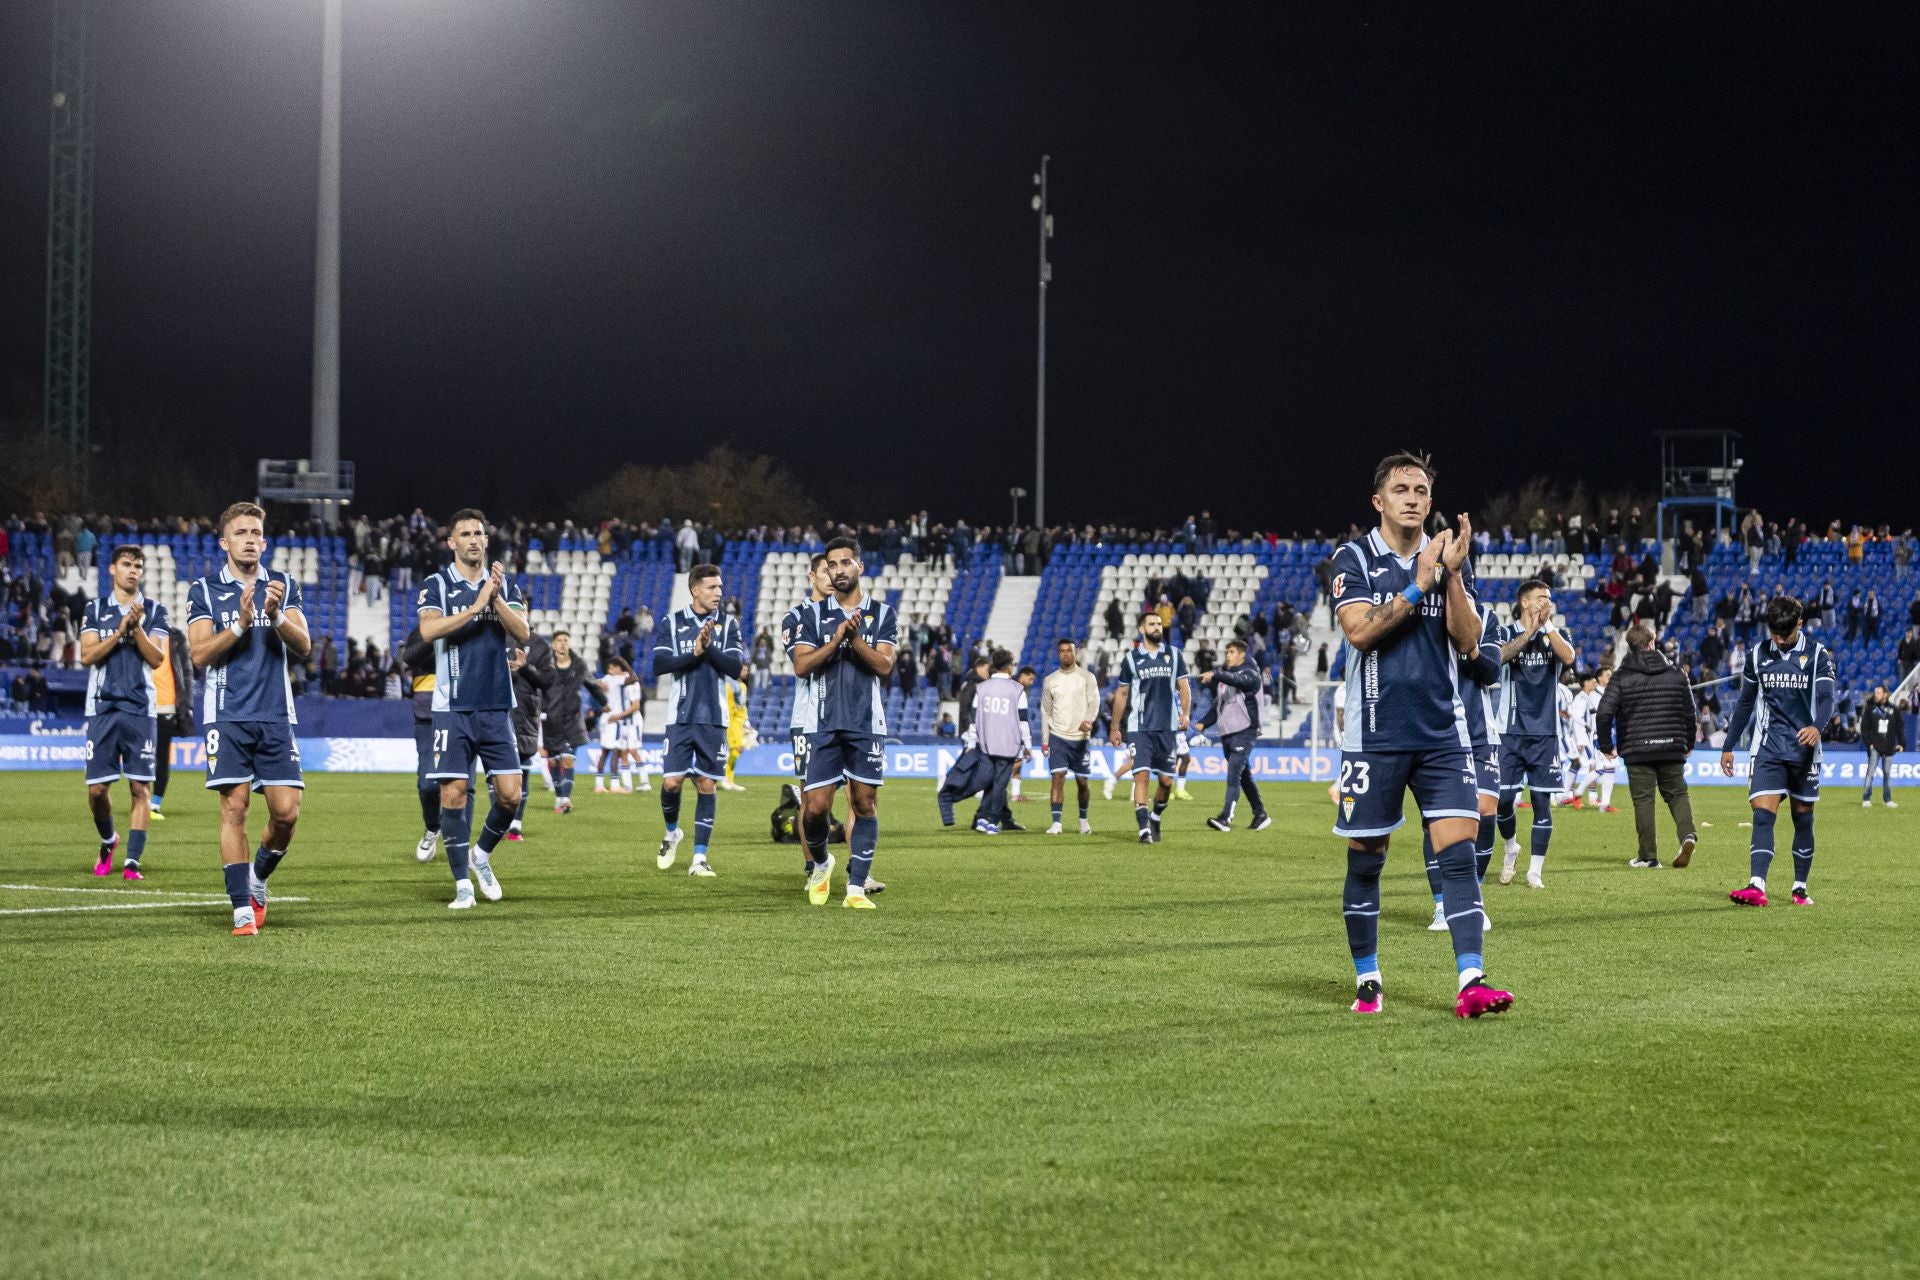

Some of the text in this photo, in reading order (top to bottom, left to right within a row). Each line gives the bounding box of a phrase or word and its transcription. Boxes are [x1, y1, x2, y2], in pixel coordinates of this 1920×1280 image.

[1762, 673, 1809, 682] BAHRAIN
[1763, 681, 1808, 689] VICTORIOUS
[983, 696, 1010, 714] 303
[86, 739, 94, 760] 8
[206, 729, 220, 755] 8
[433, 729, 449, 752] 21
[793, 735, 807, 756] 18
[894, 753, 929, 772] DE
[1823, 763, 1836, 778] Y
[1841, 763, 1854, 778] 2
[1340, 760, 1371, 795] 23
